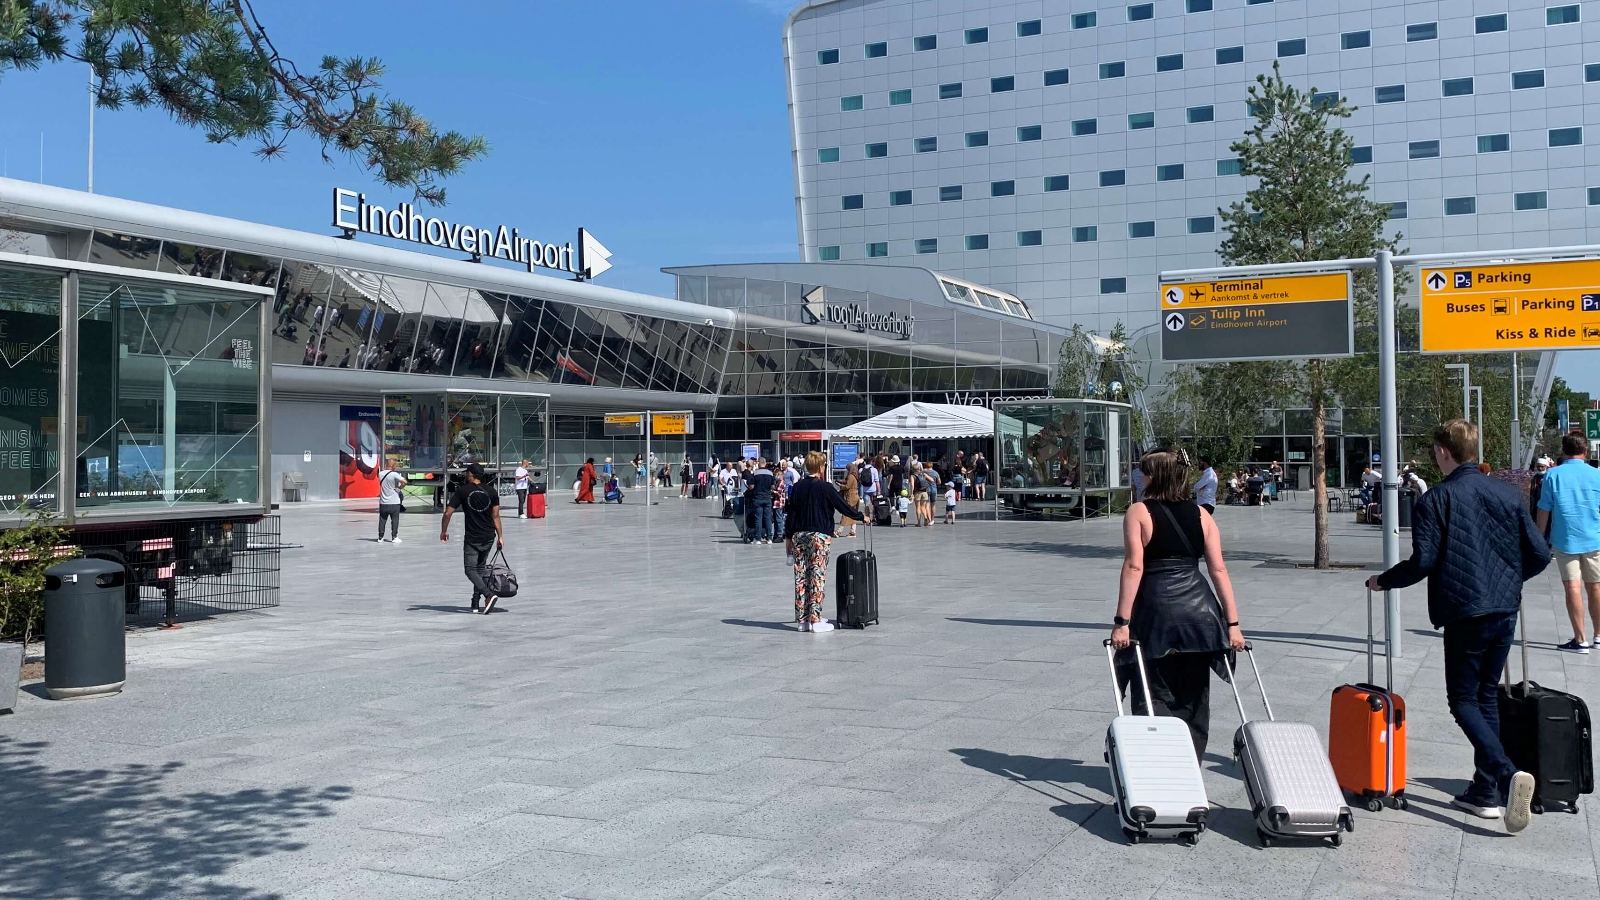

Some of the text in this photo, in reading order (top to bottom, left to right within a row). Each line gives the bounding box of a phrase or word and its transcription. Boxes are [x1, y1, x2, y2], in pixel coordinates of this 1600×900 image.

[333, 187, 575, 272] EindhovenAirport
[1478, 271, 1531, 284] Parking
[1210, 280, 1263, 292] Terminal
[1210, 294, 1250, 302] Aankomst
[1261, 291, 1289, 299] vertrek
[1447, 302, 1486, 313] Buses
[1521, 298, 1575, 312] Parking
[1210, 308, 1265, 320] Tulip Inn
[1210, 318, 1287, 329] Eindhoven Airport
[1496, 326, 1576, 340] Kiss & Ride
